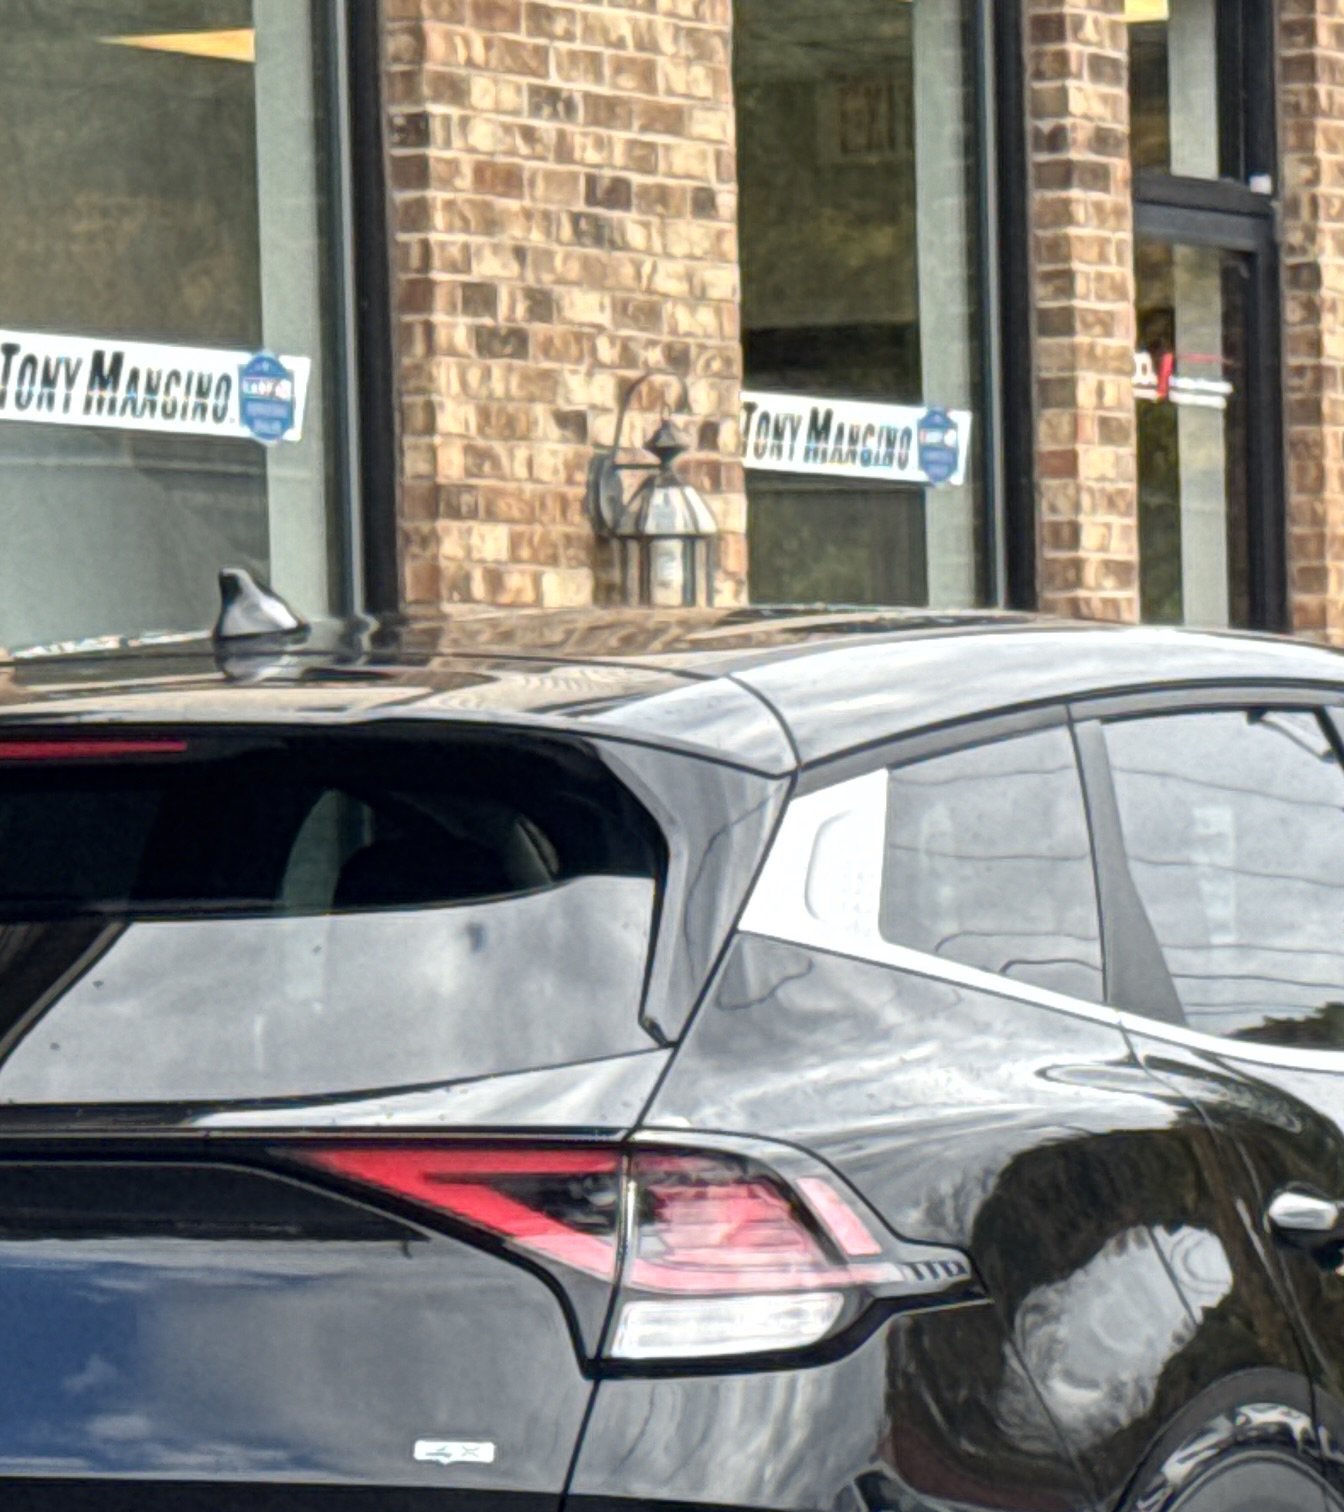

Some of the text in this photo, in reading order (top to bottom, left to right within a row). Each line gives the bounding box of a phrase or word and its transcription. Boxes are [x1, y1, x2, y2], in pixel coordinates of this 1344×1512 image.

[82, 349, 232, 424] MANGINO
[740, 401, 803, 463] TONY
[803, 406, 913, 470] MANGINO
